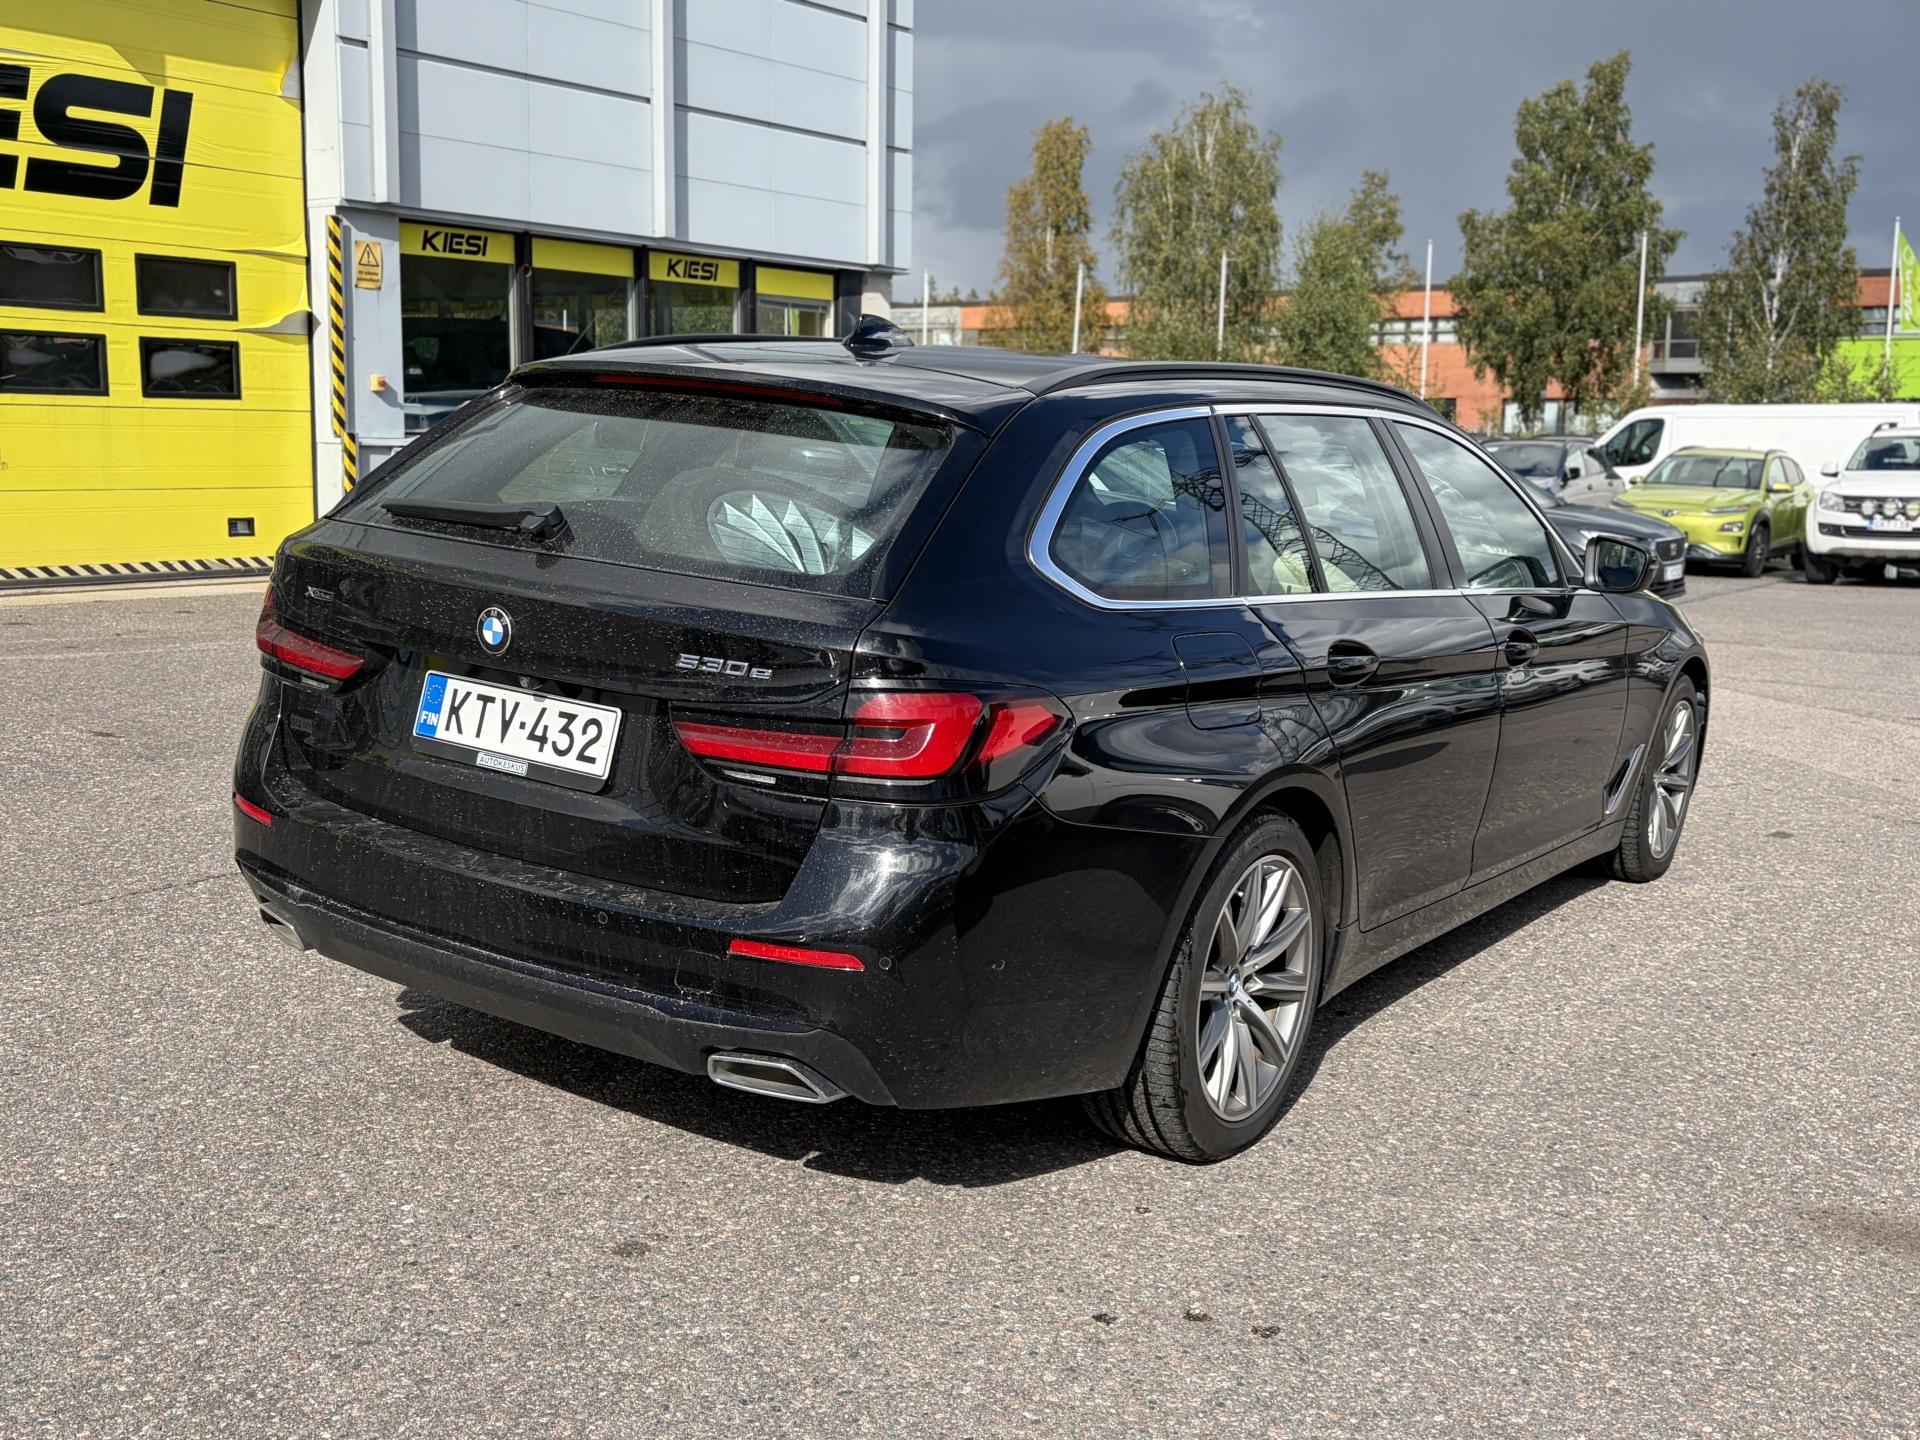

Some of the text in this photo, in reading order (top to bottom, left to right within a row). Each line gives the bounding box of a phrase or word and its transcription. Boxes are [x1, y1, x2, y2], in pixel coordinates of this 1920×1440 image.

[421, 230, 488, 257] KIESI
[667, 258, 719, 282] KIESI
[675, 653, 773, 680] 530e
[420, 710, 439, 727] FIN
[444, 688, 604, 765] KTV-432
[479, 756, 525, 773] AUTOKESKUS
